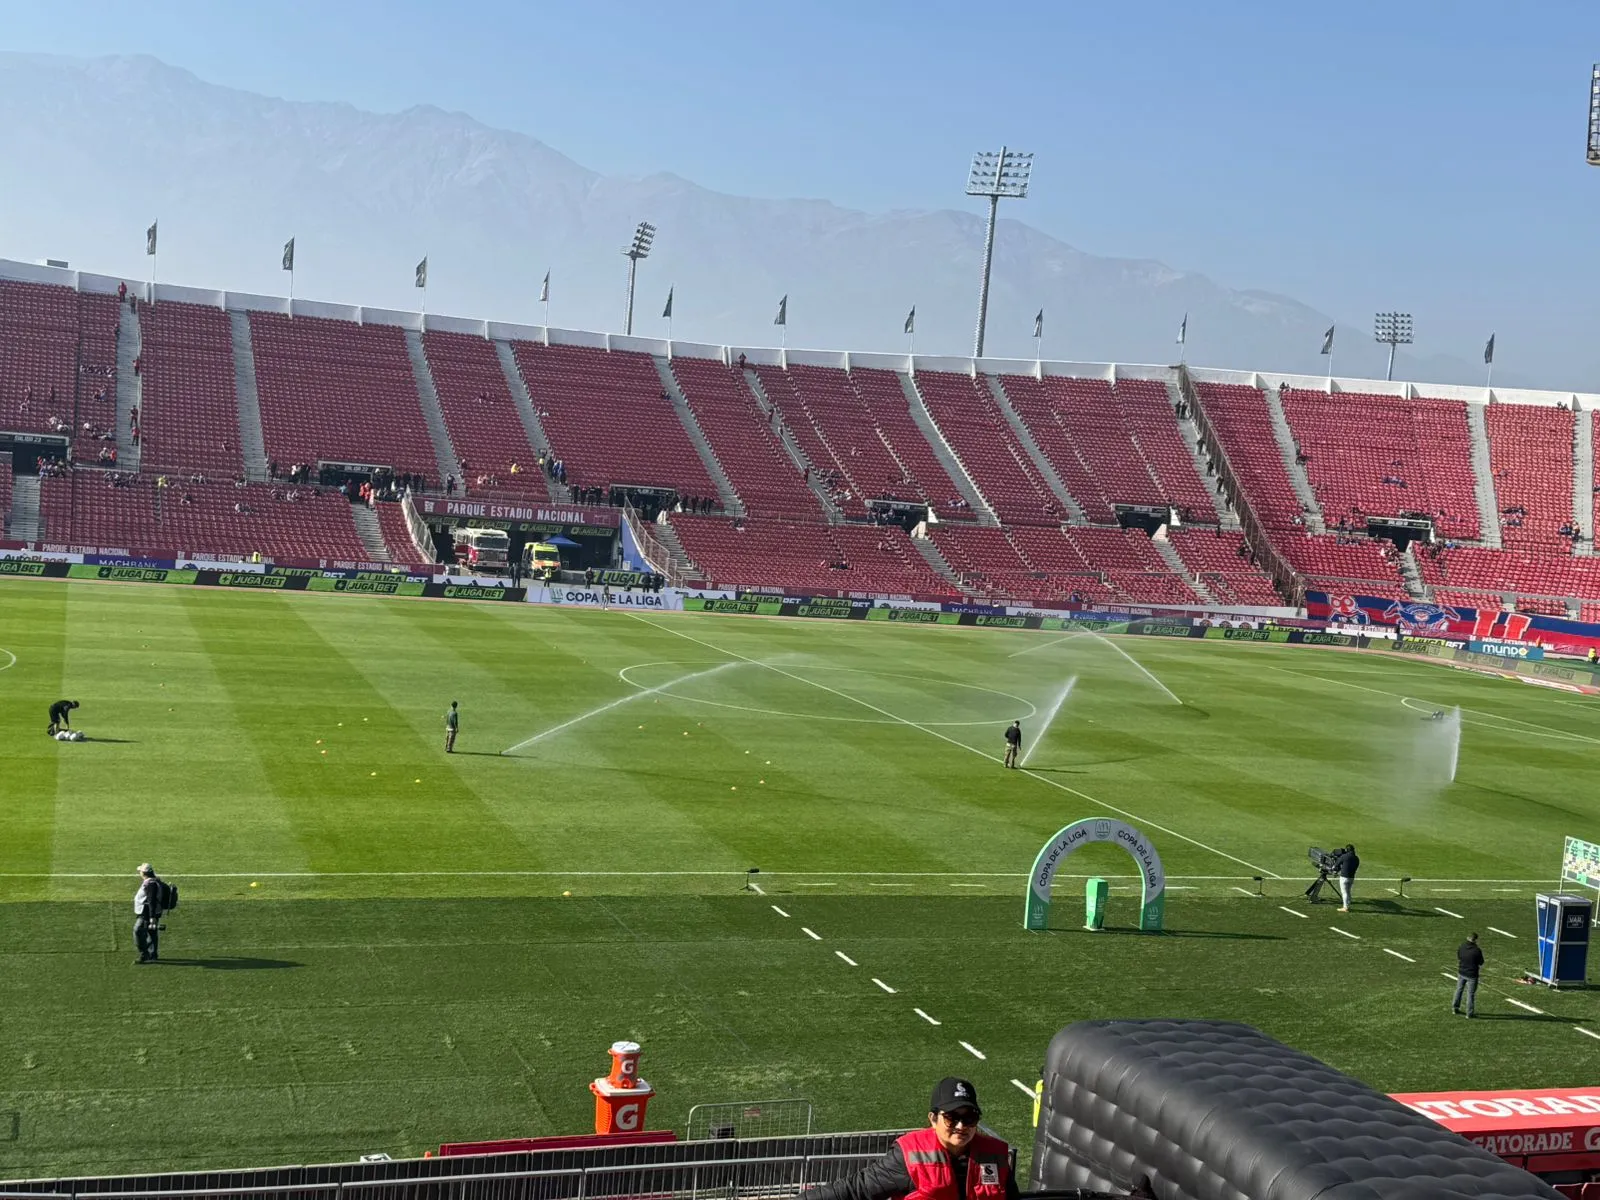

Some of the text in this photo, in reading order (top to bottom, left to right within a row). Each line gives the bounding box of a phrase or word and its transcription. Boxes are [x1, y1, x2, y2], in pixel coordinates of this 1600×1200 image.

[447, 503, 486, 517] PARQUE
[490, 505, 532, 521] ESTADIO
[537, 509, 586, 524] NACIONAL
[42, 543, 131, 556] PARQUE ESTADIO NACIONAL
[191, 552, 216, 562] PARQUE
[333, 561, 357, 569] PARQUE
[357, 562, 383, 571] ESTADIO
[113, 568, 168, 580] JUGABET
[234, 575, 286, 586] JUGABET
[348, 581, 398, 592] JUGABET
[459, 588, 505, 599] JUGABET
[566, 591, 600, 604] COPA
[618, 594, 634, 605] LA
[635, 595, 662, 606] LIGA
[716, 600, 758, 612] JUGABET
[1040, 829, 1088, 887] COPA DE LA LIGA
[1117, 830, 1157, 889] COPA DE LA LIGA
[621, 1060, 634, 1074] G
[1403, 1095, 1600, 1121] TORAD
[615, 1103, 639, 1130] G
[1583, 1127, 1600, 1151] G
